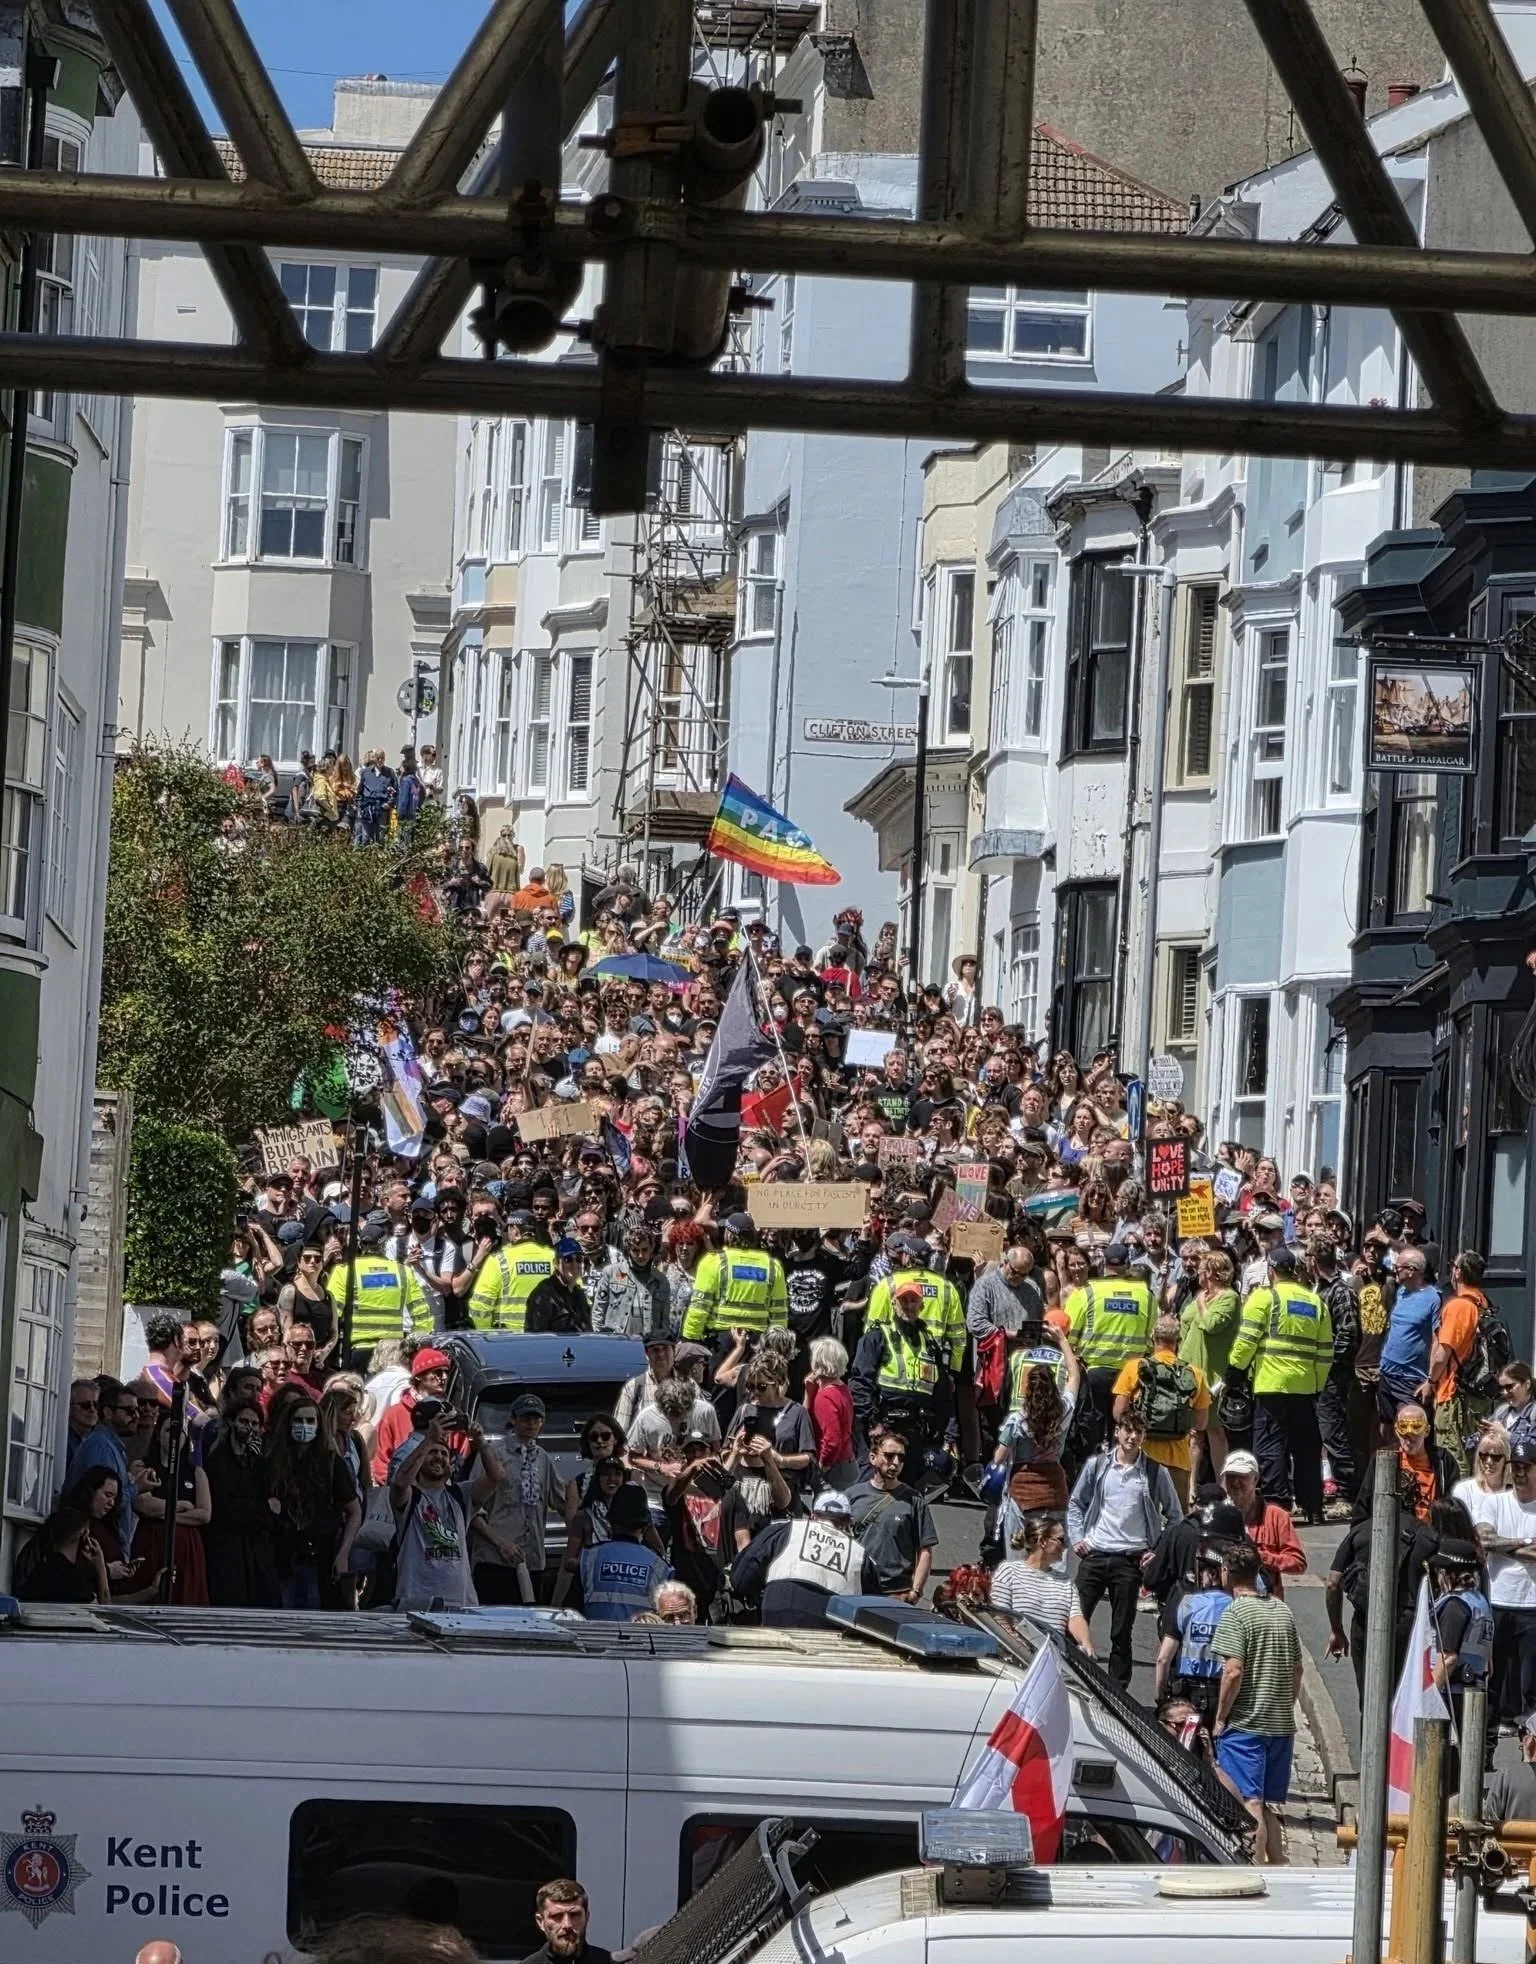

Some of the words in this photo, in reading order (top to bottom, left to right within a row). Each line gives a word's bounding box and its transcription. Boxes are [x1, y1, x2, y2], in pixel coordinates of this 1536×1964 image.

[810, 723, 865, 737] CLIFTON
[1375, 752, 1407, 763] BATTLE
[1415, 755, 1465, 766] TRAFALGAR
[262, 1122, 332, 1145] IMMIGRANTS
[265, 1139, 307, 1160] BUILT
[889, 1153, 908, 1163] NOT
[959, 1166, 987, 1180] LOVE
[1152, 1158, 1184, 1177] HOPE
[757, 1189, 769, 1199] NO
[774, 1189, 801, 1199] PLACE
[769, 1201, 779, 1209] IN
[517, 1263, 549, 1274] POLICE
[1105, 1303, 1138, 1312] POLICE
[1028, 1350, 1060, 1360] POLICE
[809, 1530, 845, 1550] PUMA
[810, 1544, 821, 1561] 3
[827, 1551, 842, 1570] A
[602, 1563, 647, 1577] POLICE
[107, 1837, 202, 1868] Kent
[106, 1885, 229, 1917] Police
